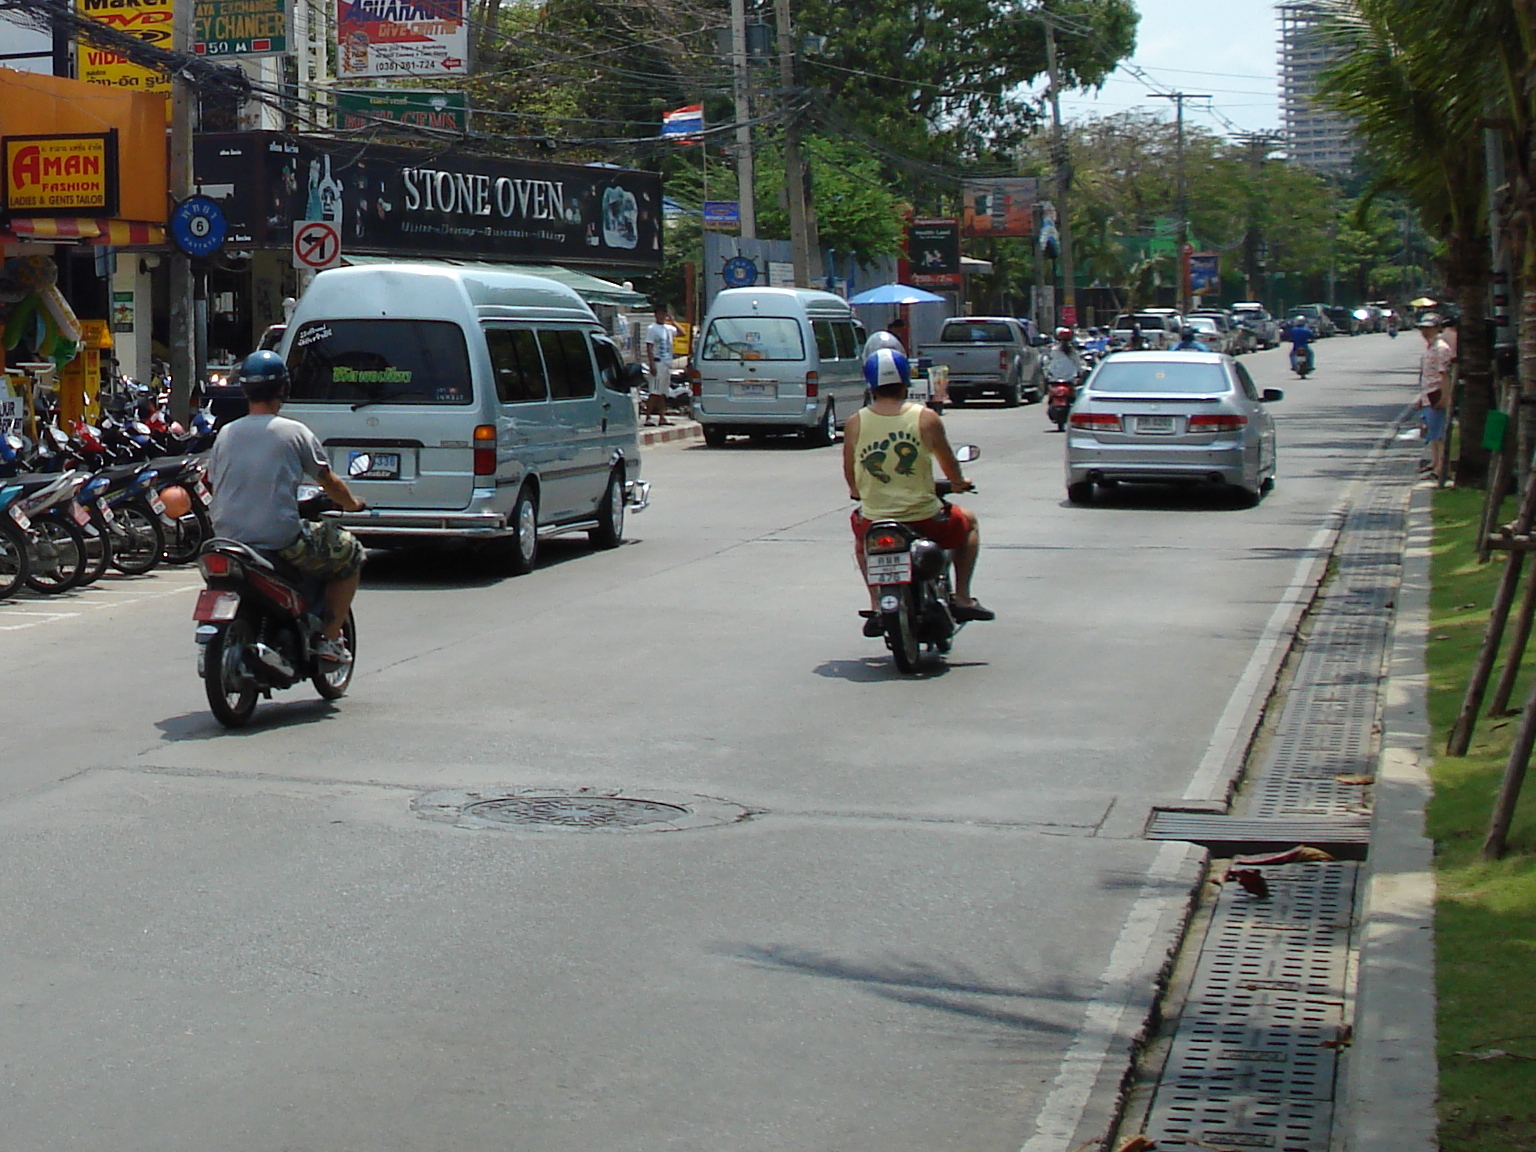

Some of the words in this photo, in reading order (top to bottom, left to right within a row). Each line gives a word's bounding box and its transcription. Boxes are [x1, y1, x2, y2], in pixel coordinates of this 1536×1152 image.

[215, 12, 286, 40] CHANGER
[378, 22, 408, 38] DIVE
[208, 41, 229, 54] 50
[12, 145, 100, 190] AMAN
[42, 181, 100, 193] FASHION
[402, 166, 490, 216] STONE
[495, 176, 565, 221] OVEN
[10, 194, 37, 206] LADIES
[48, 194, 74, 205] GENTS
[76, 194, 103, 205] TAILOR
[196, 221, 204, 232] 6
